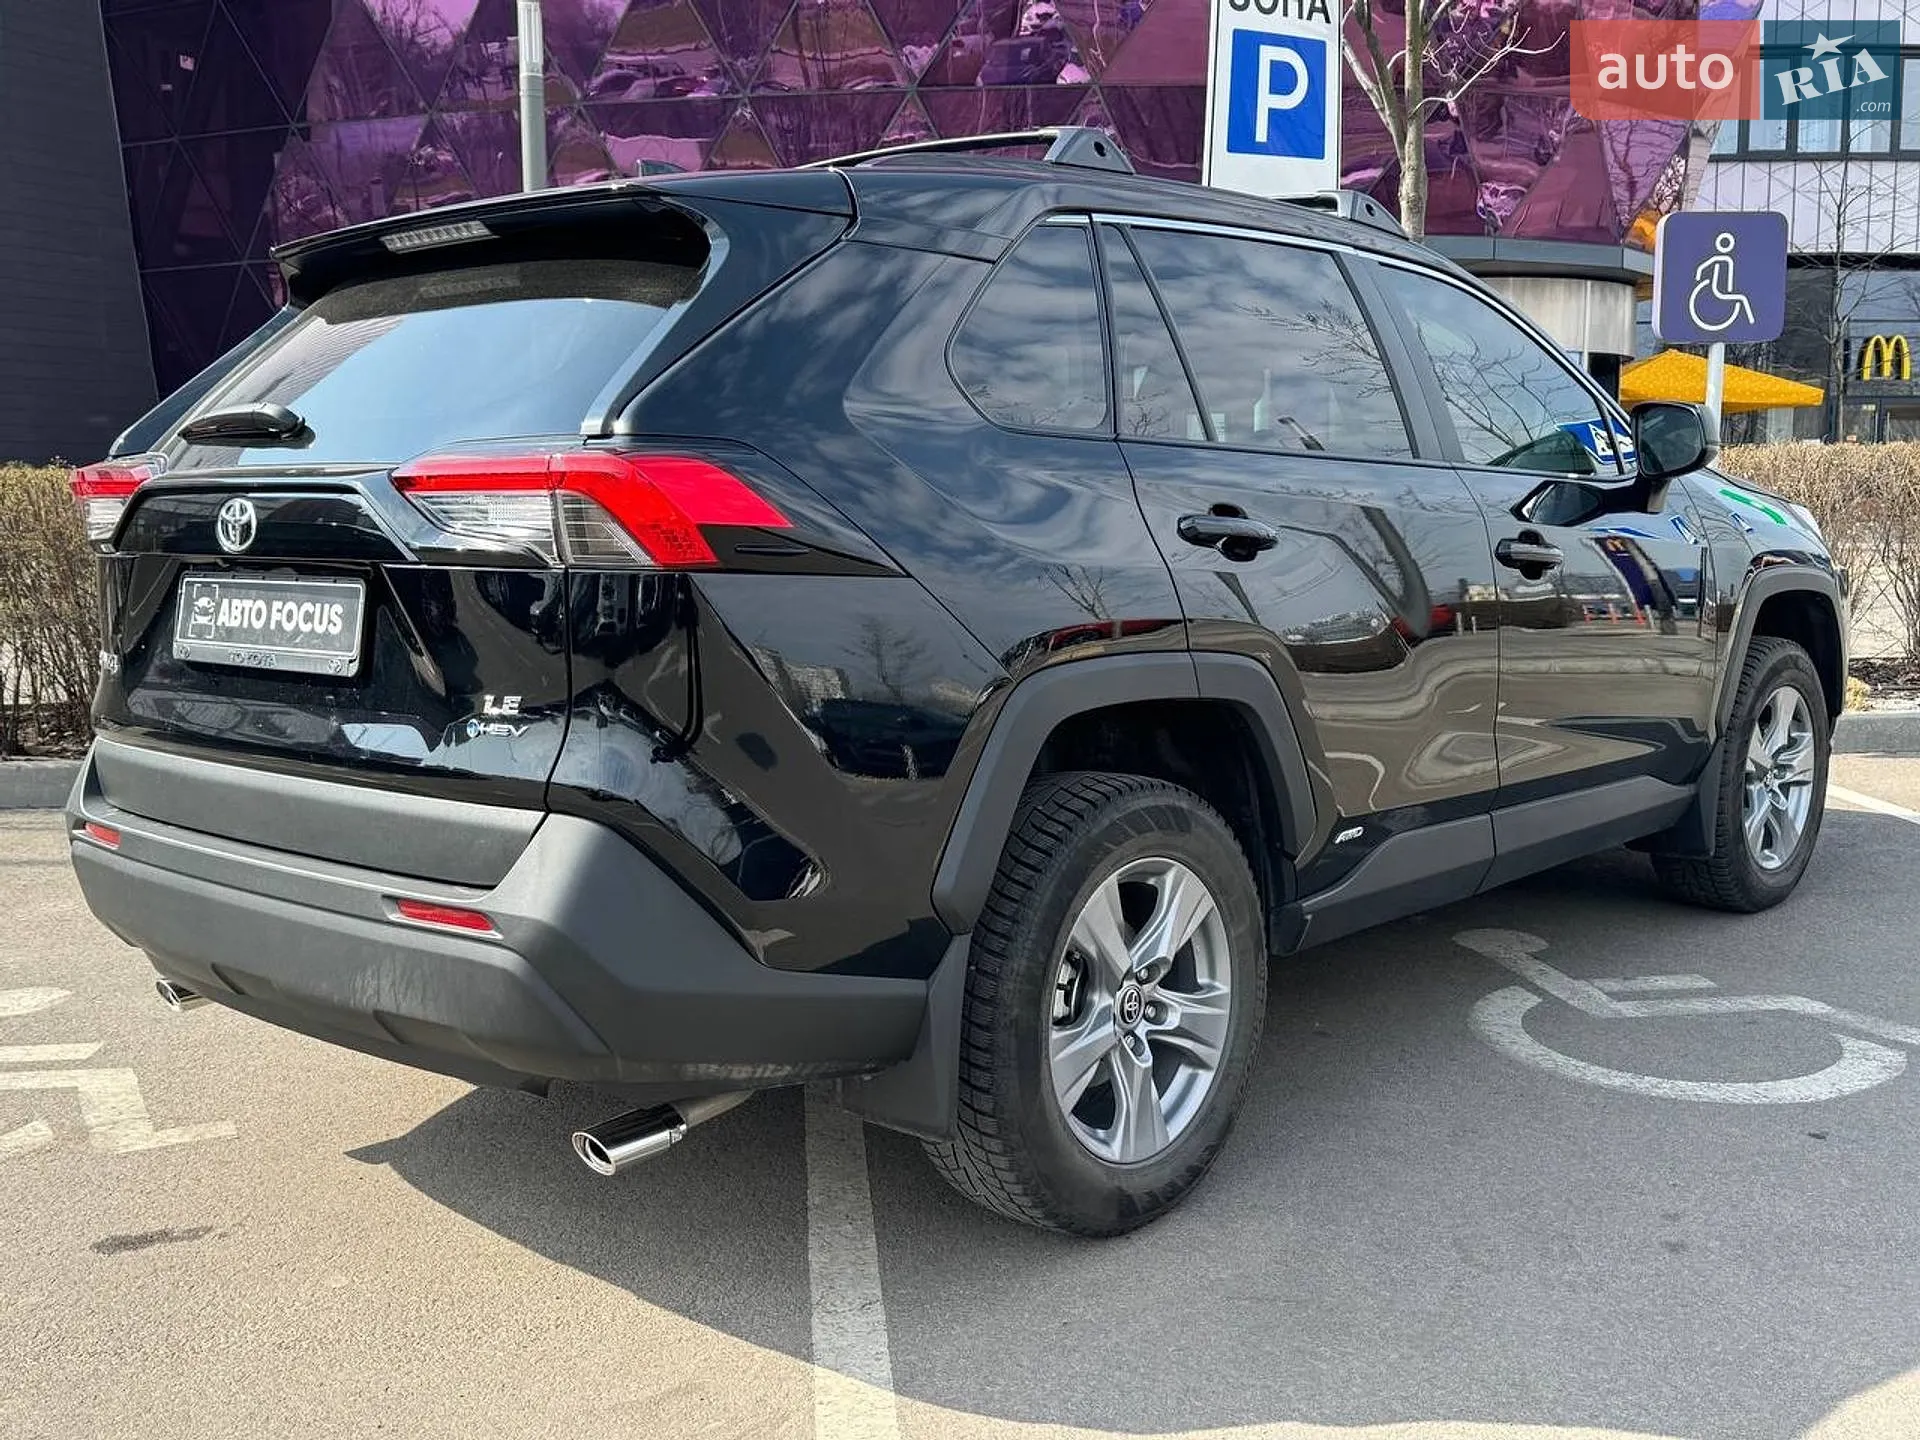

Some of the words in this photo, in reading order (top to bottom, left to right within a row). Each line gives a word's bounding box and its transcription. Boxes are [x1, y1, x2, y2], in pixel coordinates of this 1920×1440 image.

[1256, 44, 1309, 143] P
[270, 601, 344, 635] FOCUS
[482, 694, 522, 715] LE
